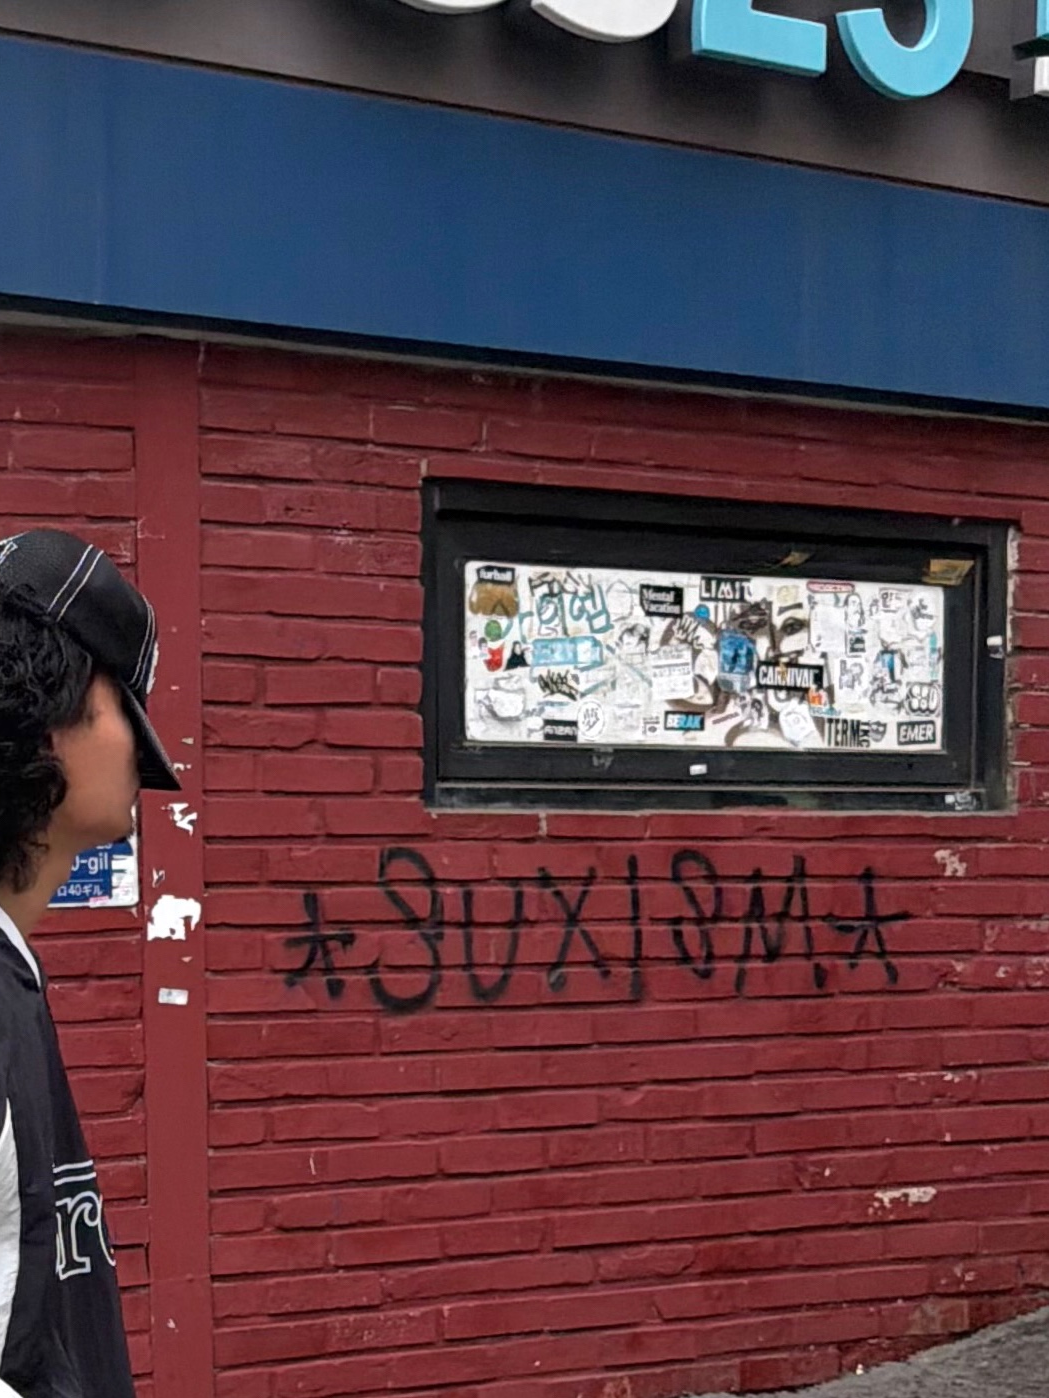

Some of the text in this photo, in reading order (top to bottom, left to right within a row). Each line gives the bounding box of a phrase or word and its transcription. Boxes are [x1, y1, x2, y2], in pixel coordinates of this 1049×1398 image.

[642, 588, 675, 602] Mental
[642, 600, 681, 614] Vacation
[758, 664, 820, 689] CARNIVAL
[899, 723, 934, 743] EMER
